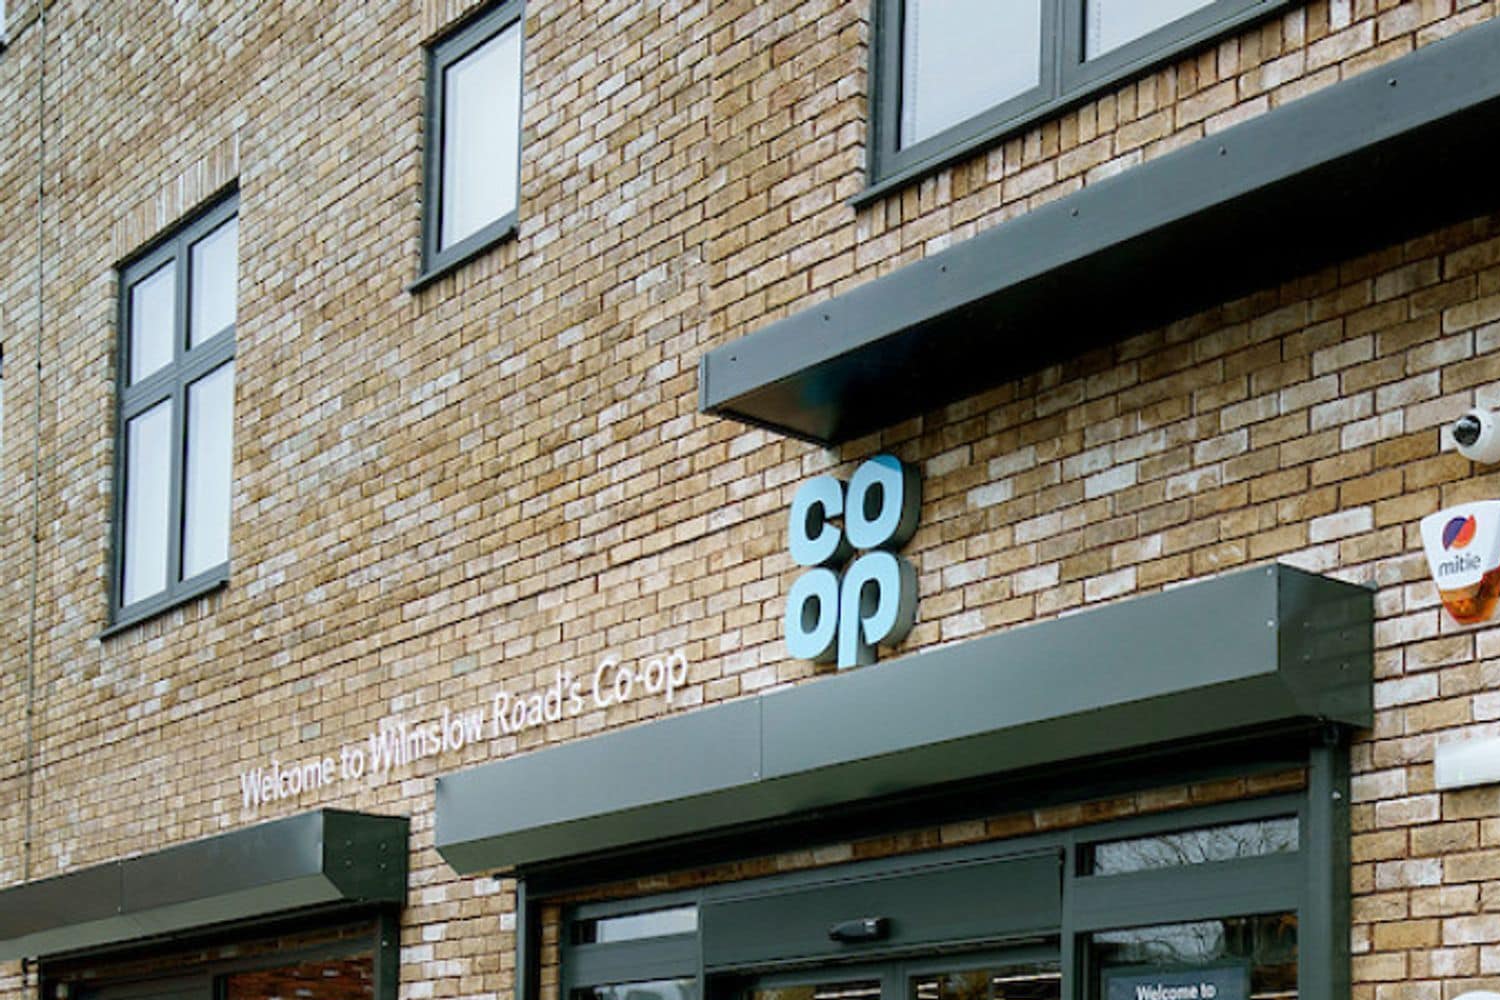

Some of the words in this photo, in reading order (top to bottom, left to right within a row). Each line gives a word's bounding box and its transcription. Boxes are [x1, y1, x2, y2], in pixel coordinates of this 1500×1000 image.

[1438, 552, 1482, 577] mitie
[240, 760, 335, 806] Welcome
[340, 743, 364, 779] to
[369, 707, 484, 773] Wilmslow
[491, 671, 582, 737] Road's
[592, 648, 688, 707] Co-op
[1200, 983, 1216, 999] to
